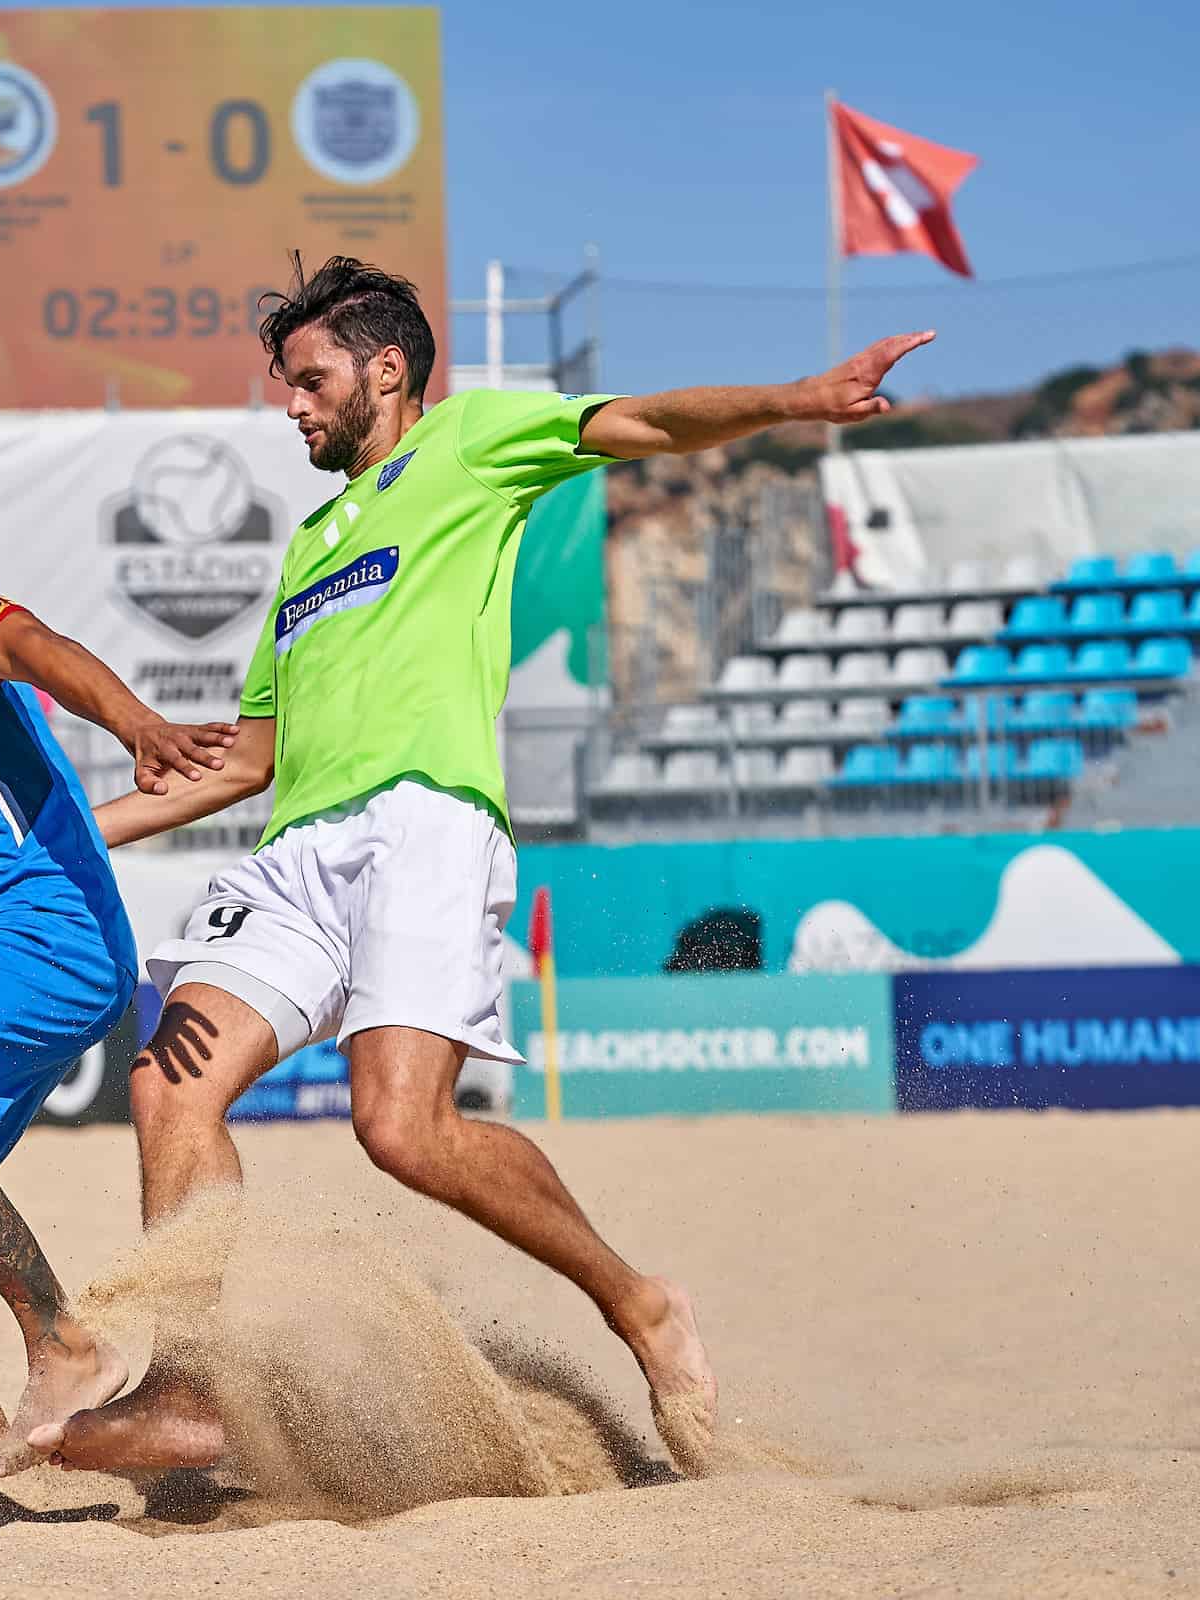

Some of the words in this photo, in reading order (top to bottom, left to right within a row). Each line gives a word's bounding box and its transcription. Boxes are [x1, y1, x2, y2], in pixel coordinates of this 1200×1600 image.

[83, 100, 123, 189] 1
[209, 98, 272, 188] 0
[206, 904, 255, 943] 9
[920, 1020, 1012, 1067] ONE
